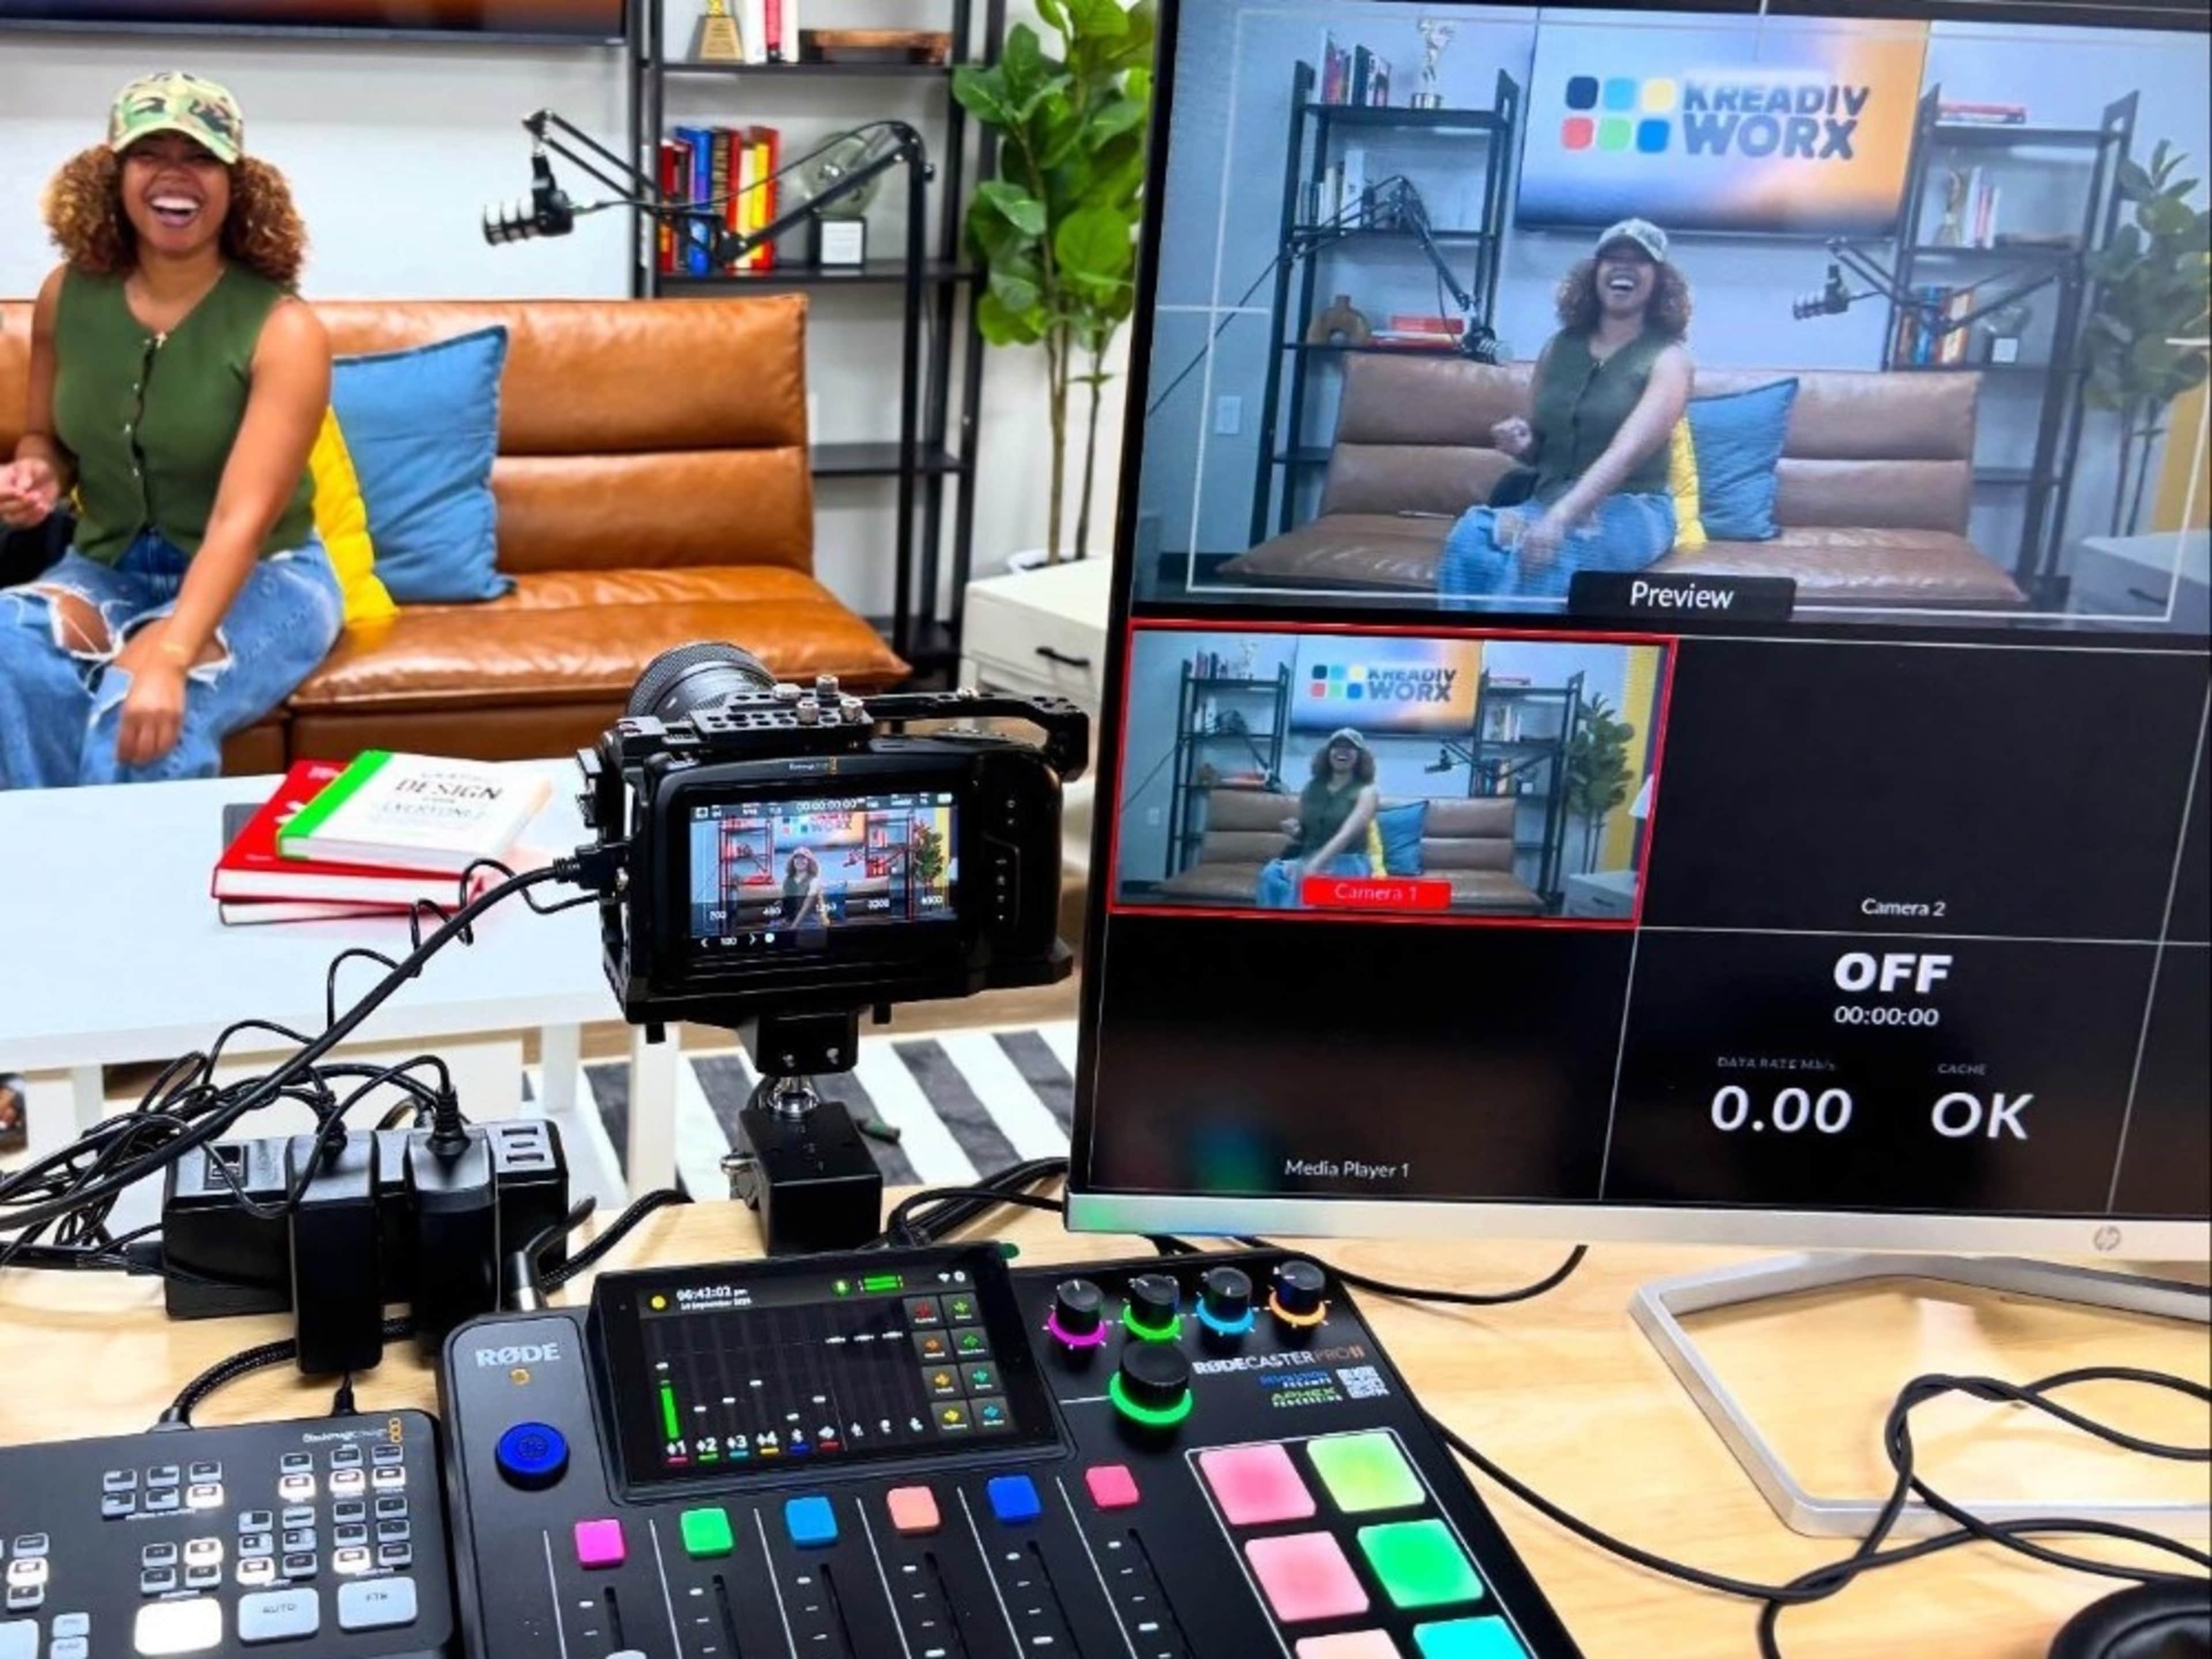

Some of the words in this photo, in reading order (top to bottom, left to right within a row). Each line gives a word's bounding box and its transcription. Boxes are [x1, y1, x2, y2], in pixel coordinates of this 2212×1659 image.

[1683, 82, 1870, 116] KREADIV
[1683, 113, 1858, 160] WORX
[1630, 581, 1734, 609] Preview
[1368, 681, 1453, 702] WORX
[1334, 883, 1403, 900] Camera
[1410, 886, 1417, 901] 1
[1861, 898, 1930, 916] Camera
[1932, 902, 1946, 916] 2
[1834, 952, 1953, 994] OFF
[1834, 1006, 1940, 1027] 00:00:00
[1717, 1057, 1755, 1069] DATA
[1937, 1063, 1987, 1076] CACHE
[1711, 1085, 1853, 1134] 0.00
[1931, 1092, 2034, 1140] OK
[1284, 1159, 1339, 1176] Media
[1343, 1160, 1396, 1179] Player
[1402, 1162, 1410, 1178] 1
[475, 1342, 561, 1368] RØDE
